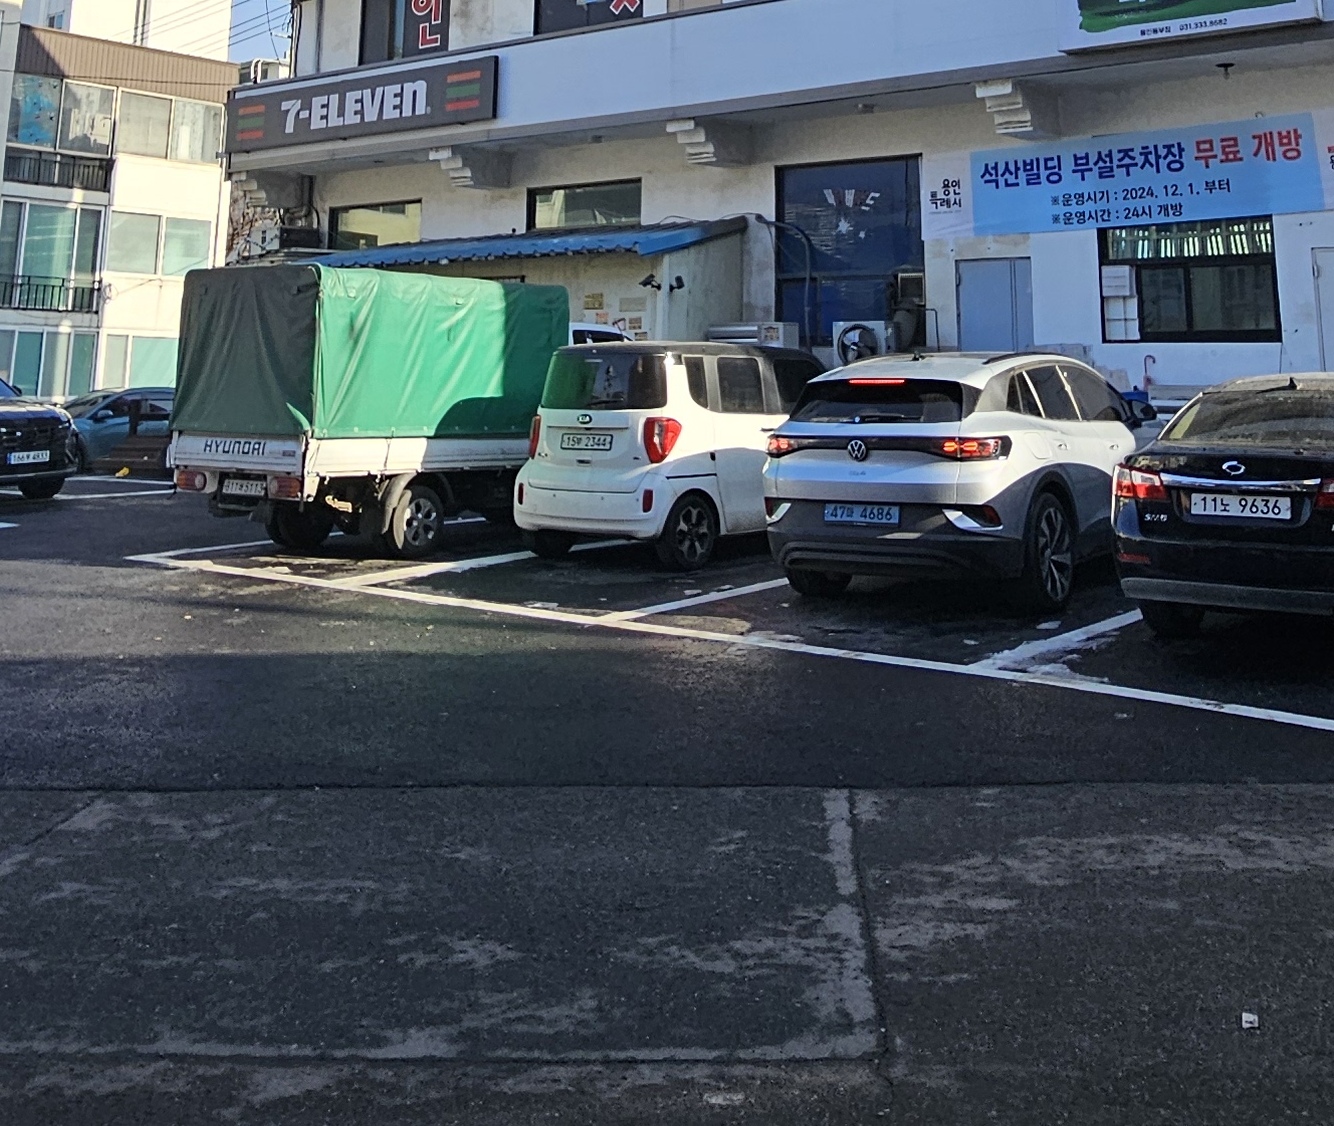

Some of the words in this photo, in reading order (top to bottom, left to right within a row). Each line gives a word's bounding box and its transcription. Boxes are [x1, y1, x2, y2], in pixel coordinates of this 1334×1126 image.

[980, 155, 1063, 189] 석산빌딩
[1071, 142, 1185, 181] 부설주차장
[1194, 136, 1244, 169] 무료
[1252, 128, 1303, 162] 개방
[941, 178, 961, 196] 용인
[1204, 178, 1231, 193] 부터
[1123, 204, 1152, 220] 24시
[1157, 202, 1183, 218] 개방
[203, 439, 267, 456] HYUNDAI
[859, 506, 893, 521] 4686
[1200, 496, 1231, 513] 11노
[1238, 498, 1282, 516] 9636
